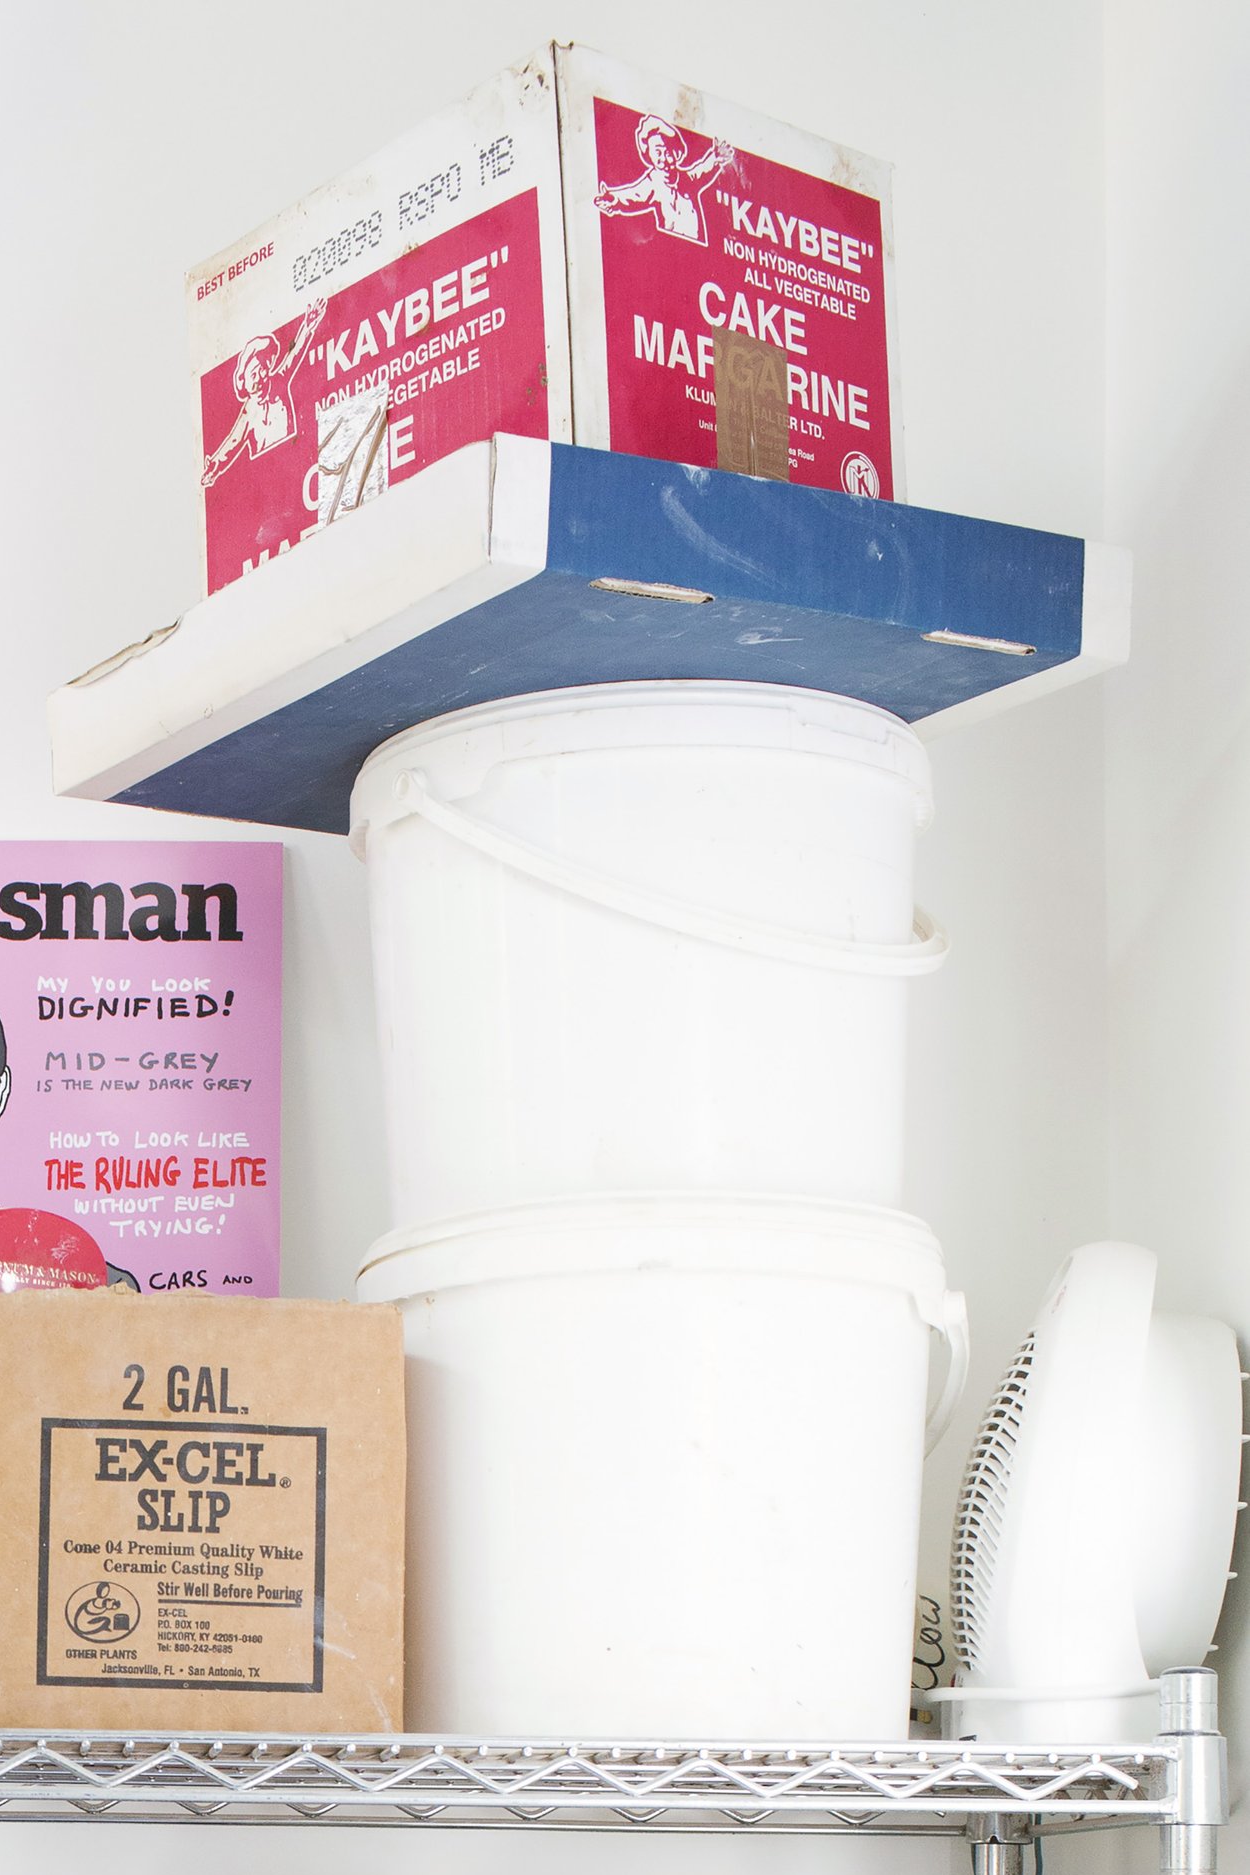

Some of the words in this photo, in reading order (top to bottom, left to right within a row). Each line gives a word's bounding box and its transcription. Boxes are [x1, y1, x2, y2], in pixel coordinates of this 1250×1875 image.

[399, 163, 461, 230] RSPO
[716, 190, 873, 273] "KAYBEE"
[197, 270, 225, 301] BEST
[228, 242, 274, 286] BEFORE
[723, 238, 755, 263] NON
[758, 250, 870, 303] HYDROGENATED
[744, 267, 771, 291] ALL
[774, 276, 856, 321] VEGETABLE
[309, 246, 509, 381] "KAYBEE"
[699, 282, 807, 355] CAKE
[315, 388, 351, 421] NON
[354, 307, 506, 395] HYDROGENATED
[388, 348, 481, 411] EGETABLE
[800, 421, 825, 440] LTD.
[37, 976, 69, 993] MY
[91, 976, 132, 993] YOU
[151, 976, 211, 992] LOOK
[38, 990, 235, 1021] DIGNIFIED!
[37, 1079, 53, 1092] IS
[61, 1079, 94, 1091] THE
[100, 1079, 141, 1092] NEW
[148, 1078, 193, 1091] DARK
[203, 1078, 253, 1092] GREY
[49, 1131, 92, 1150] HOW
[95, 1131, 119, 1148] TO
[134, 1131, 189, 1149] LOOK
[197, 1131, 250, 1149] LIKE
[44, 1159, 86, 1192] THE
[95, 1155, 182, 1194] RULING
[193, 1157, 267, 1189] ELITE
[74, 1195, 165, 1216] WITHOUT
[174, 1193, 235, 1212] EVEN
[110, 1214, 226, 1239] TRYING!
[49, 1267, 98, 1285] MASON
[149, 1270, 208, 1290] CARS
[223, 1274, 253, 1285] AND
[122, 1363, 145, 1411] 2
[166, 1365, 249, 1415] GAL.
[137, 1488, 231, 1534] SLIP
[63, 1539, 100, 1554] Cone
[105, 1540, 123, 1554] 04
[128, 1540, 195, 1557] Premium
[200, 1543, 255, 1561] Quality
[259, 1545, 304, 1560] White
[103, 1559, 167, 1574] Ceramic
[171, 1560, 229, 1578] Casting
[234, 1562, 264, 1579] Slip
[157, 1581, 180, 1596] Stir
[183, 1582, 209, 1598] Well
[213, 1583, 253, 1599] Before
[257, 1585, 304, 1603] Pouring
[158, 1608, 188, 1618] EX-CEL
[175, 1620, 192, 1630] BOX
[195, 1621, 211, 1631] 100
[66, 1649, 97, 1659] OTHER
[99, 1650, 138, 1660] PLANTS
[101, 1663, 161, 1676] Jacksonville,
[164, 1665, 175, 1675] FL
[188, 1666, 205, 1676] San
[248, 1668, 260, 1678] TX
